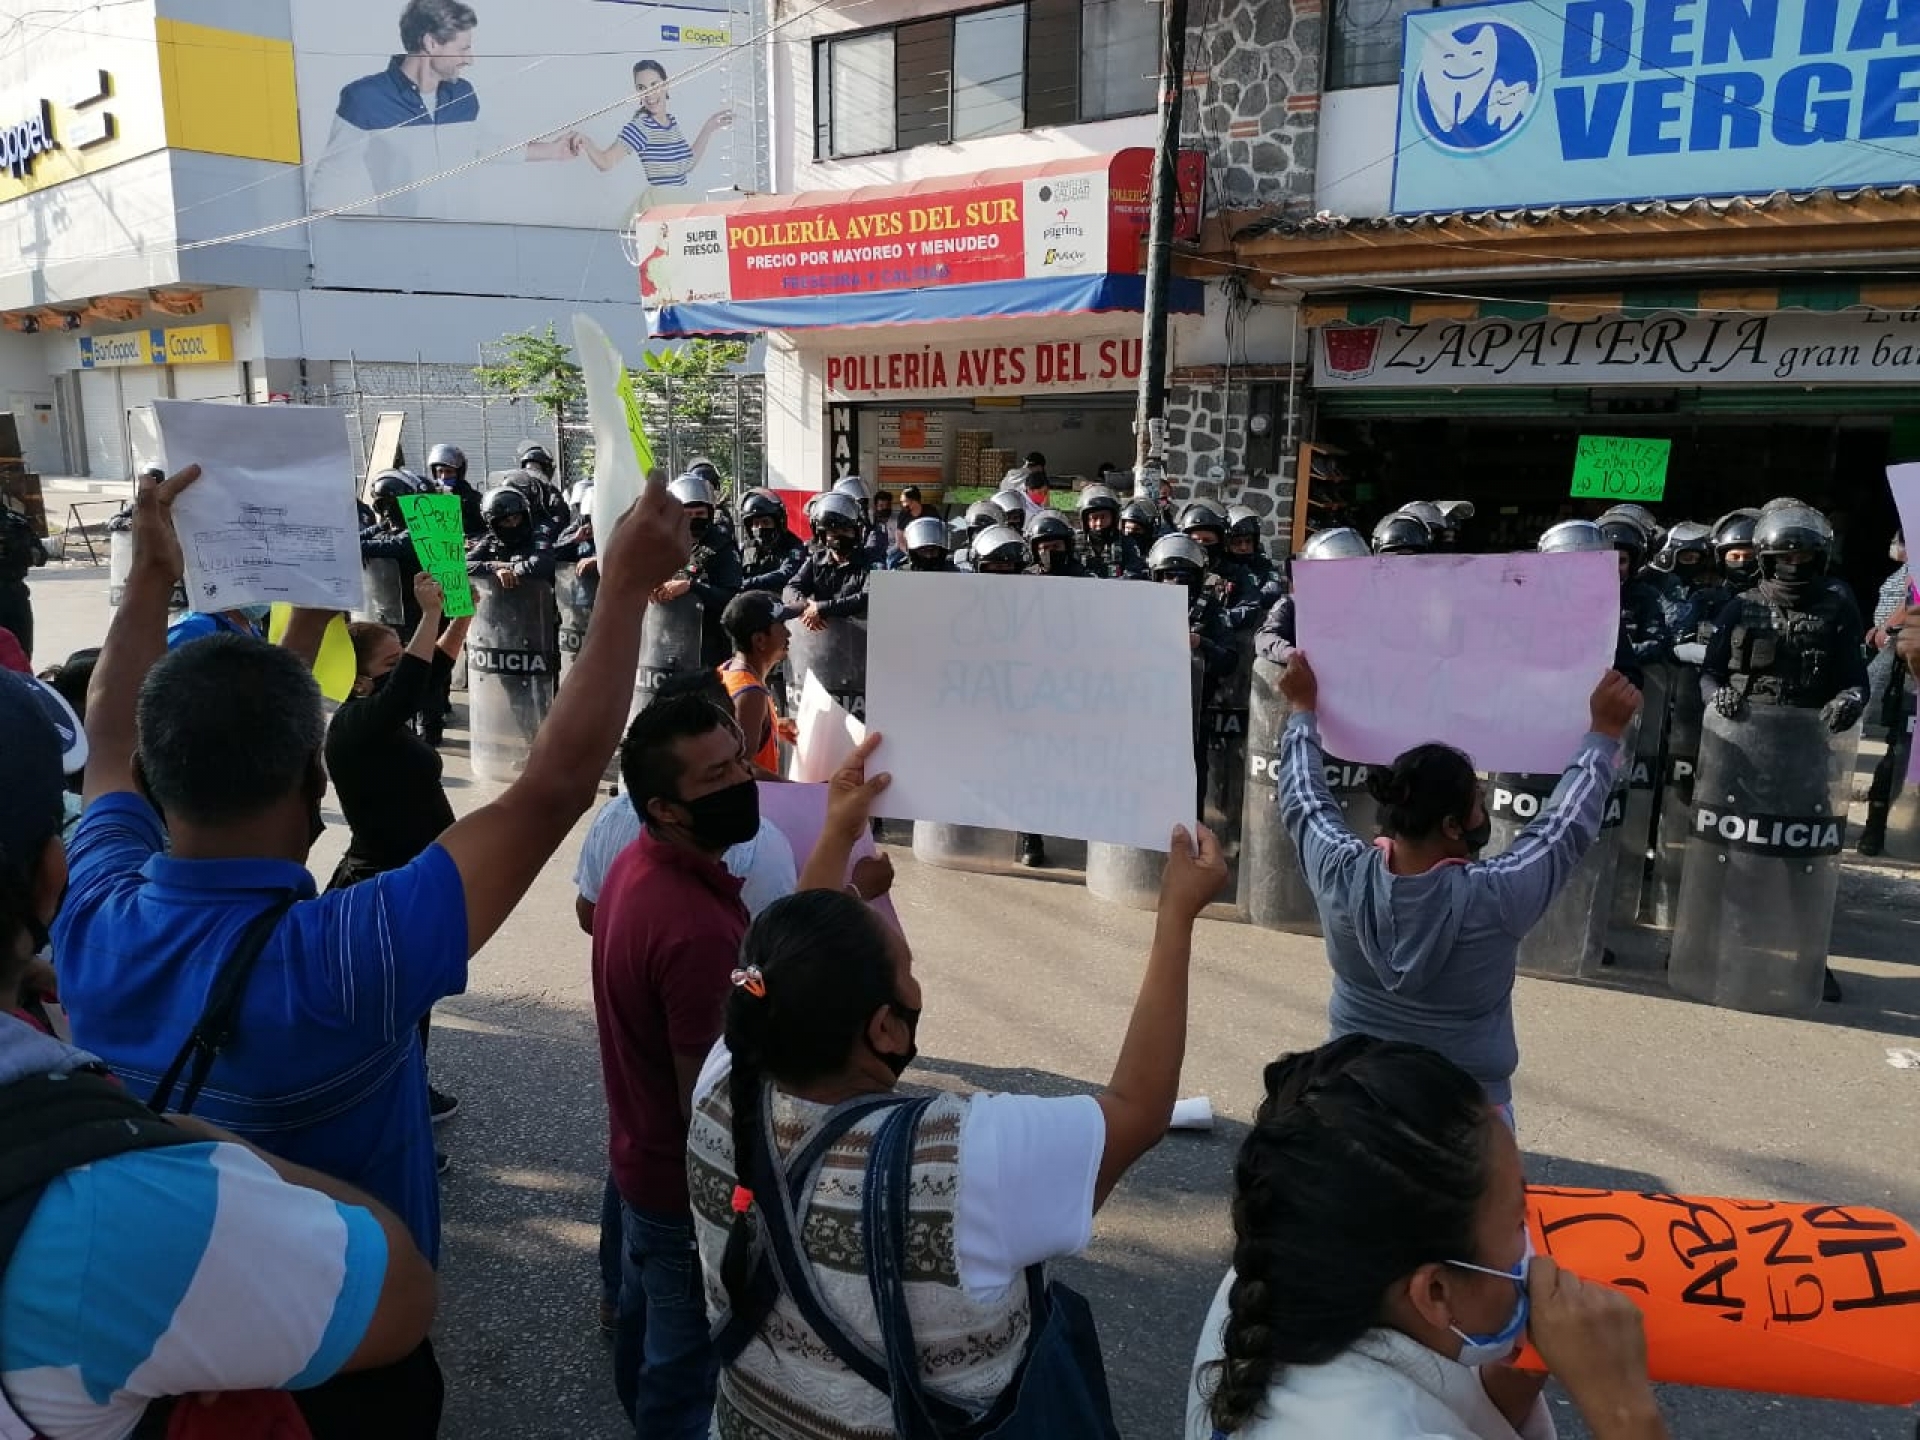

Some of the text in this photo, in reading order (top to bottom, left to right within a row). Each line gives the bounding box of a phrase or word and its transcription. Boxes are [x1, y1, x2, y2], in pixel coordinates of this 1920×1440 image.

[1553, 55, 1920, 161] VERGE
[686, 230, 718, 243] SUPER
[728, 197, 1021, 250] POLLERÍA AVES DEL SUR
[746, 233, 1000, 270] PRECIO POR MAYOREO Y MENUDEO
[782, 271, 861, 289] FRESCURA
[867, 271, 877, 285] Y
[827, 338, 1143, 393] POLLERÍA AVES DEL SU
[1774, 333, 1920, 378] gran ba
[469, 649, 547, 672] POLICIA
[1697, 809, 1840, 848] POLICIA
